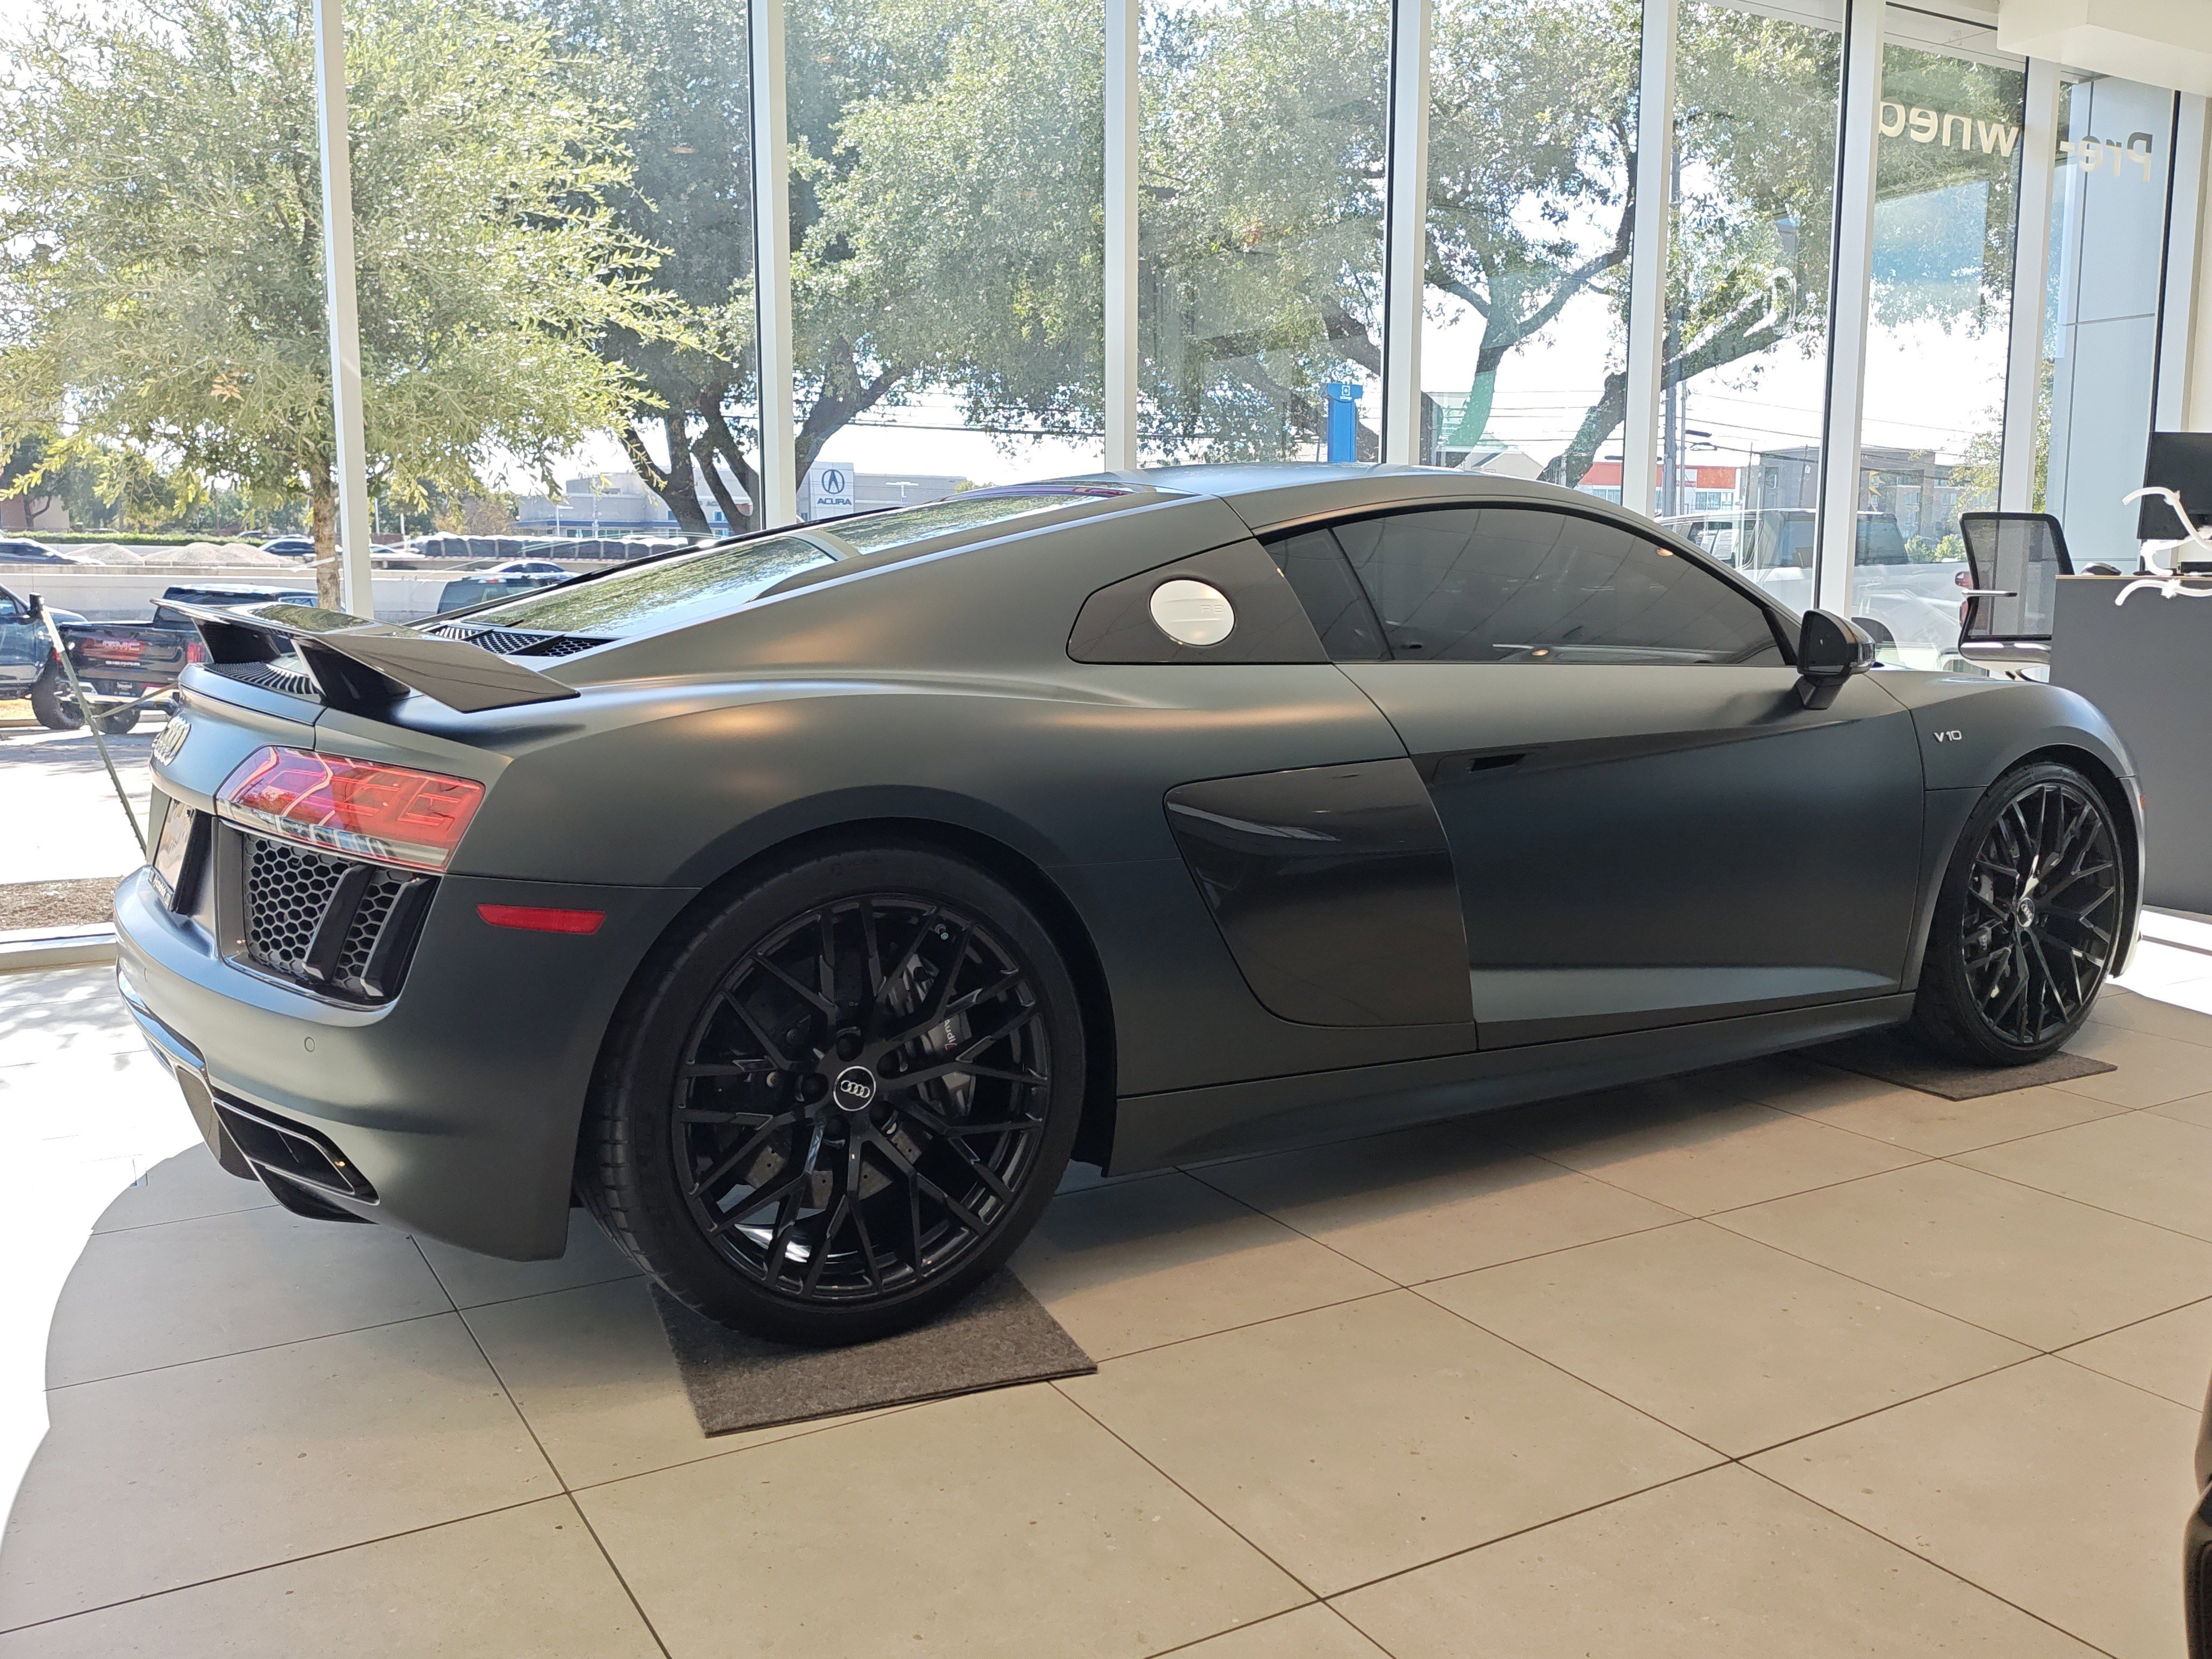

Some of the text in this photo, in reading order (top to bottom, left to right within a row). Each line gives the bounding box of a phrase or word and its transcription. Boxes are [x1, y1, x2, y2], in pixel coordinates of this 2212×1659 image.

[1200, 604, 1224, 614] R8
[1933, 730, 1962, 742] V10
[944, 1019, 956, 1043] Audi
